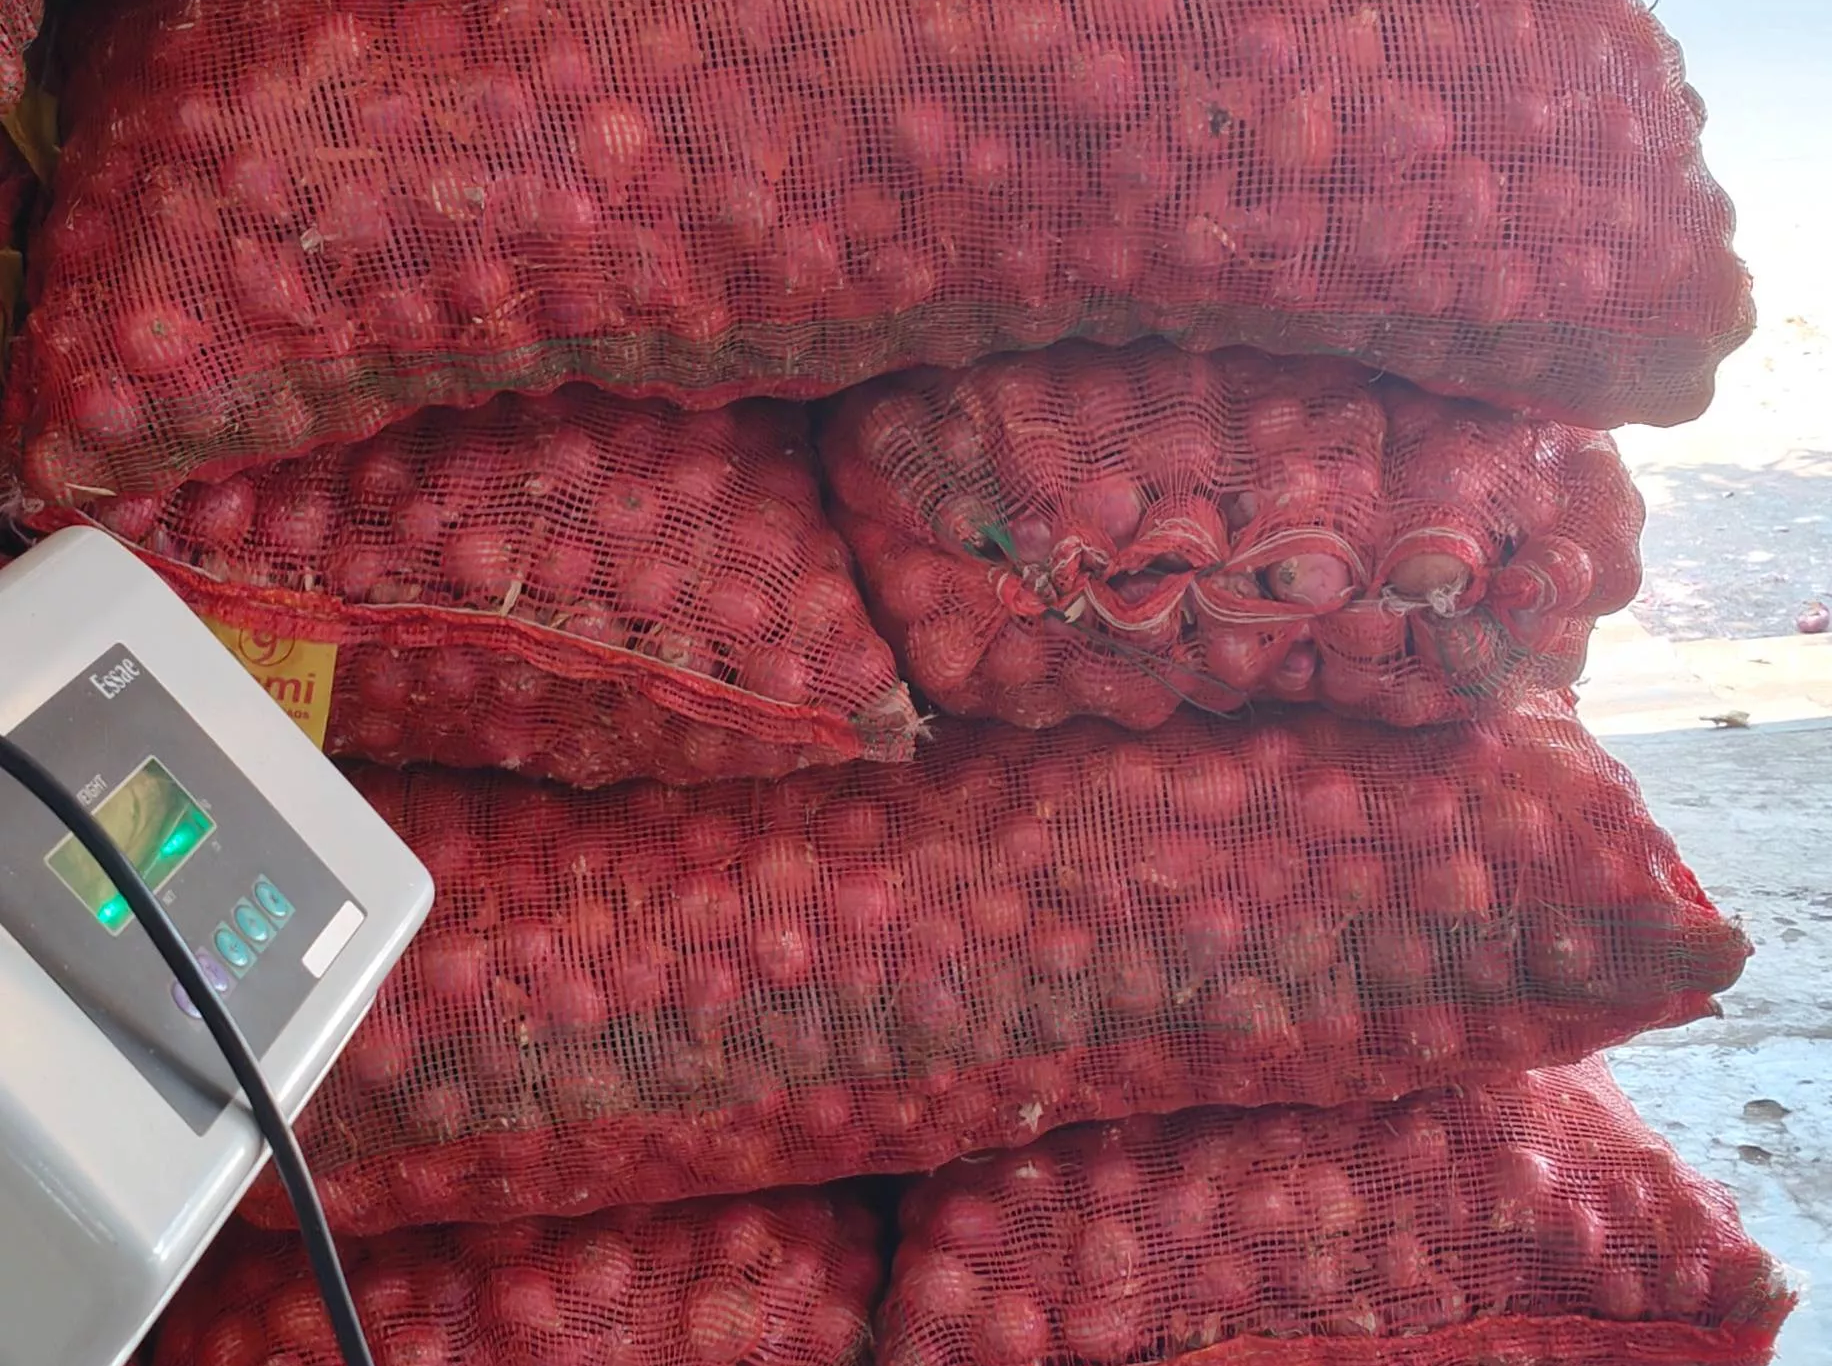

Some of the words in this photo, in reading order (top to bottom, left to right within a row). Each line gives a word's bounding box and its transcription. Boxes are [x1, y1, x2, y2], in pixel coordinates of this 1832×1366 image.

[89, 658, 140, 699] Essae
[254, 673, 316, 704] mi
[76, 773, 108, 806] EIGHT
